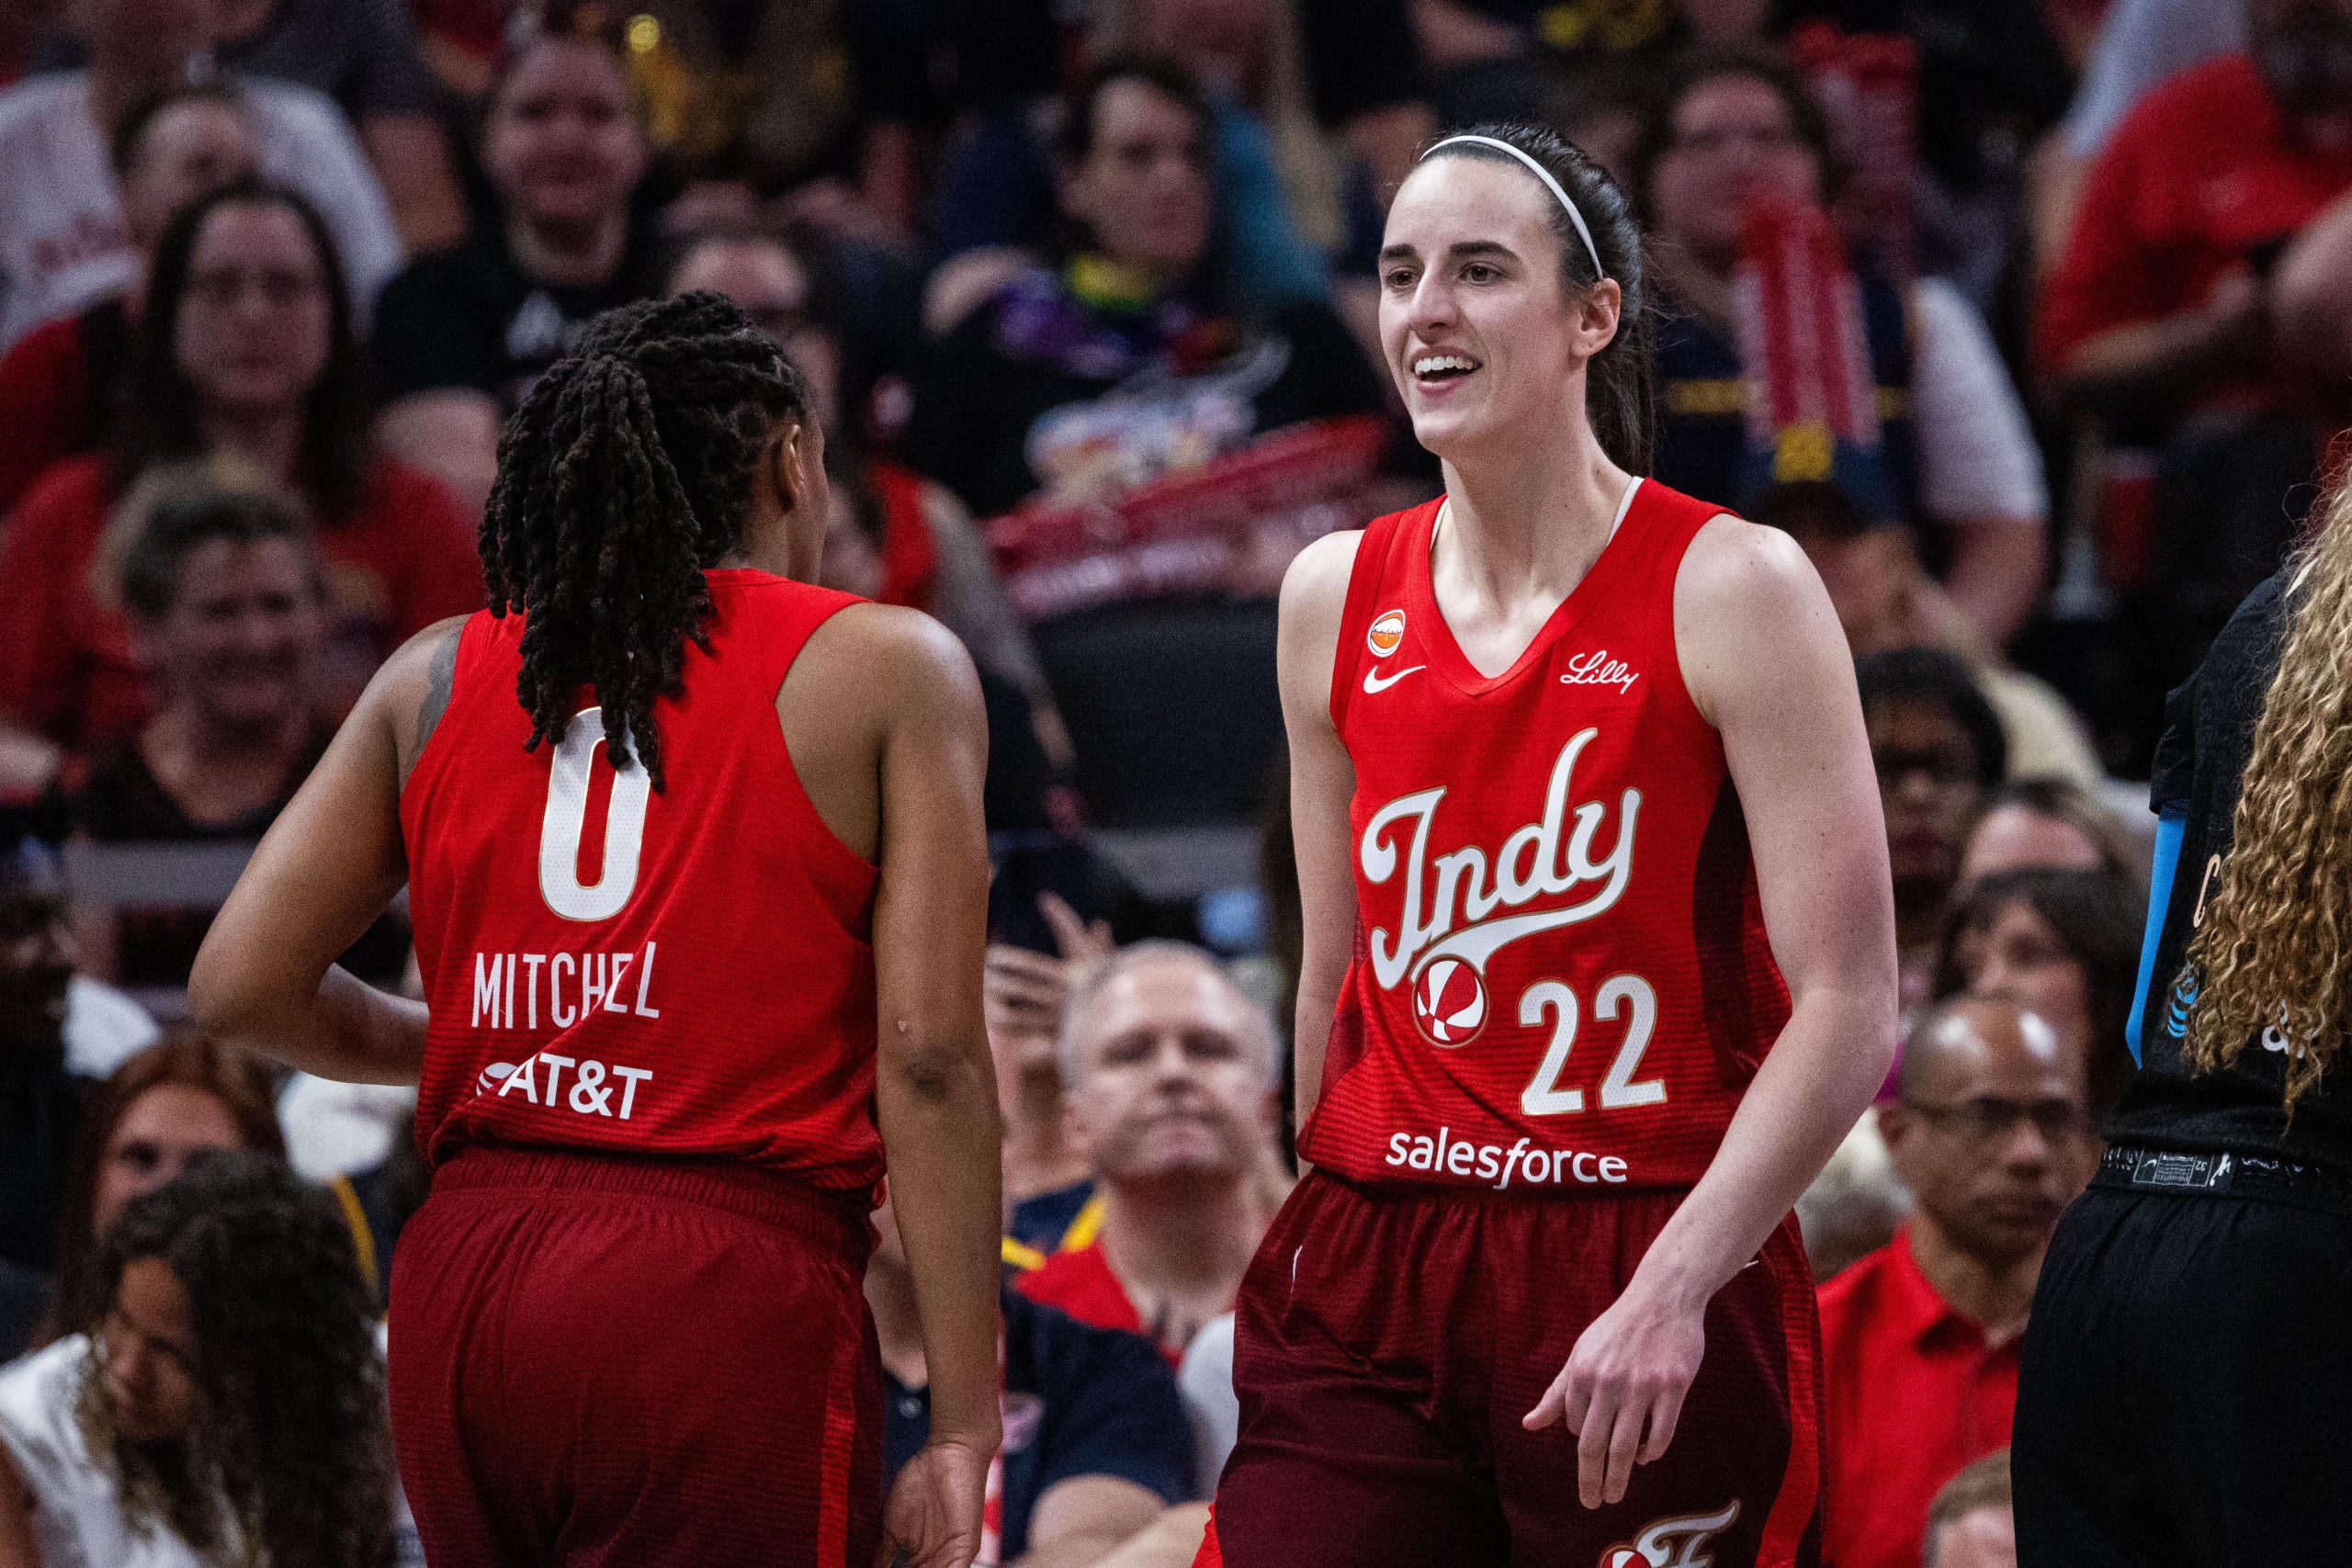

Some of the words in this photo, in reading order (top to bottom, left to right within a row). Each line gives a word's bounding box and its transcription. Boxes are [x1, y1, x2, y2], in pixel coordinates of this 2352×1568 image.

[1560, 649, 1639, 694] Lilly
[538, 705, 650, 921] 0
[1360, 728, 1643, 990] Indy
[498, 1054, 653, 1120] AT&T
[1518, 973, 1667, 1115] 22
[1385, 1127, 1628, 1190] salesforce
